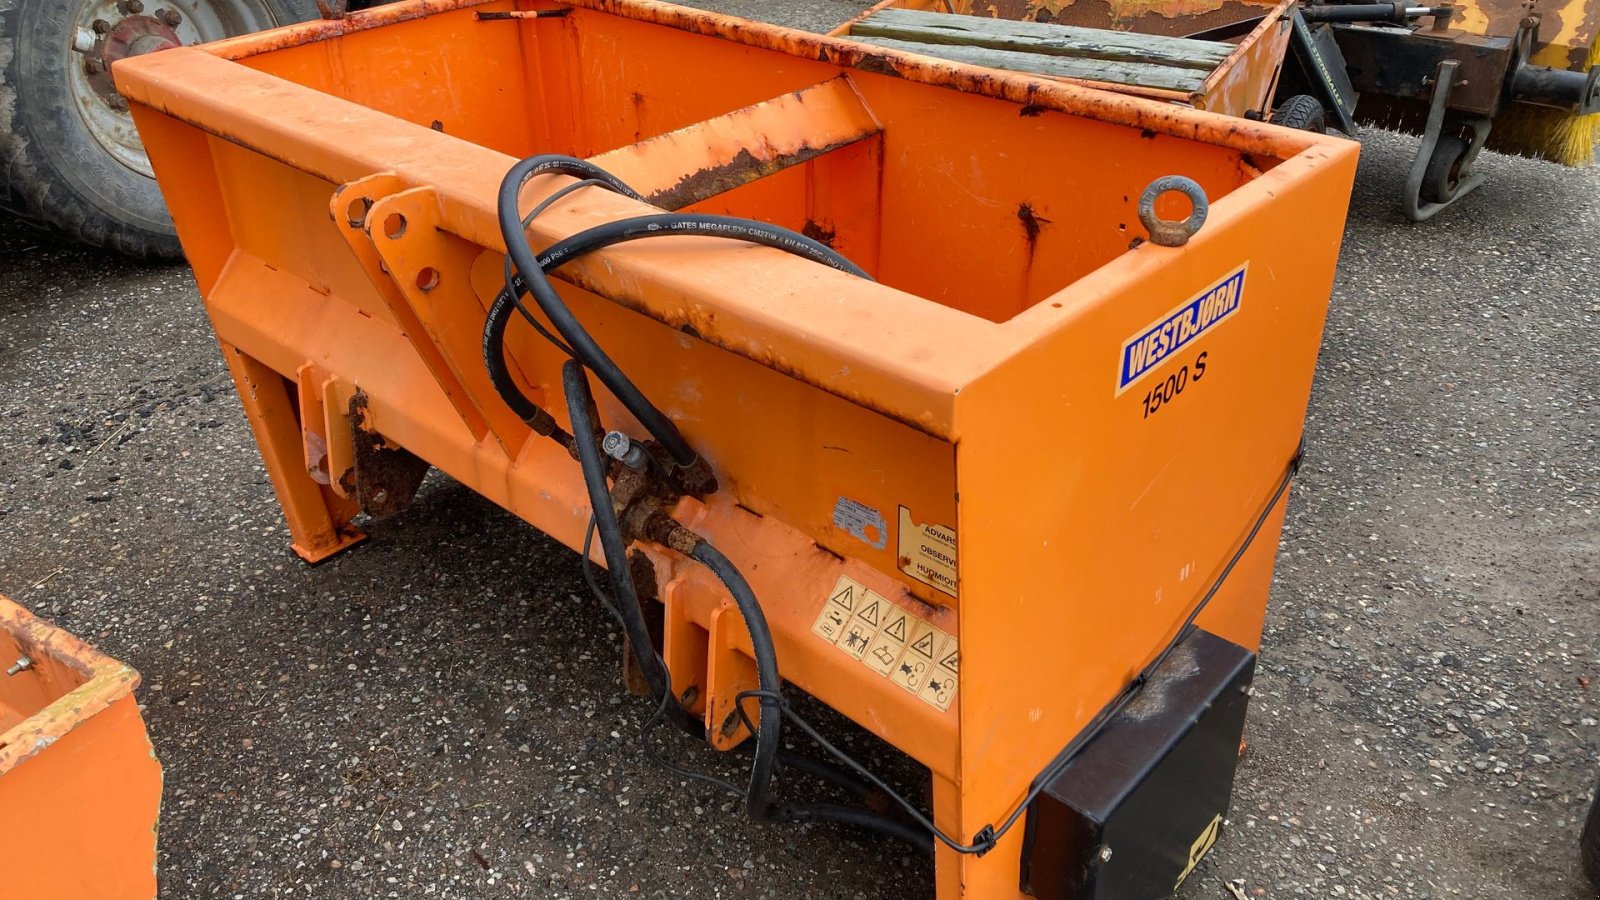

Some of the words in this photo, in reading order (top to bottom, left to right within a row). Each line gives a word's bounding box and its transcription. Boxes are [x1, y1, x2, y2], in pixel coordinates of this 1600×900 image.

[1312, 46, 1343, 106] STENSBALLE
[809, 247, 823, 259] 2SC
[827, 256, 839, 268] ISO
[1129, 275, 1240, 379] WESTBJØRN
[1143, 366, 1188, 419] 1500
[1193, 351, 1207, 382] S
